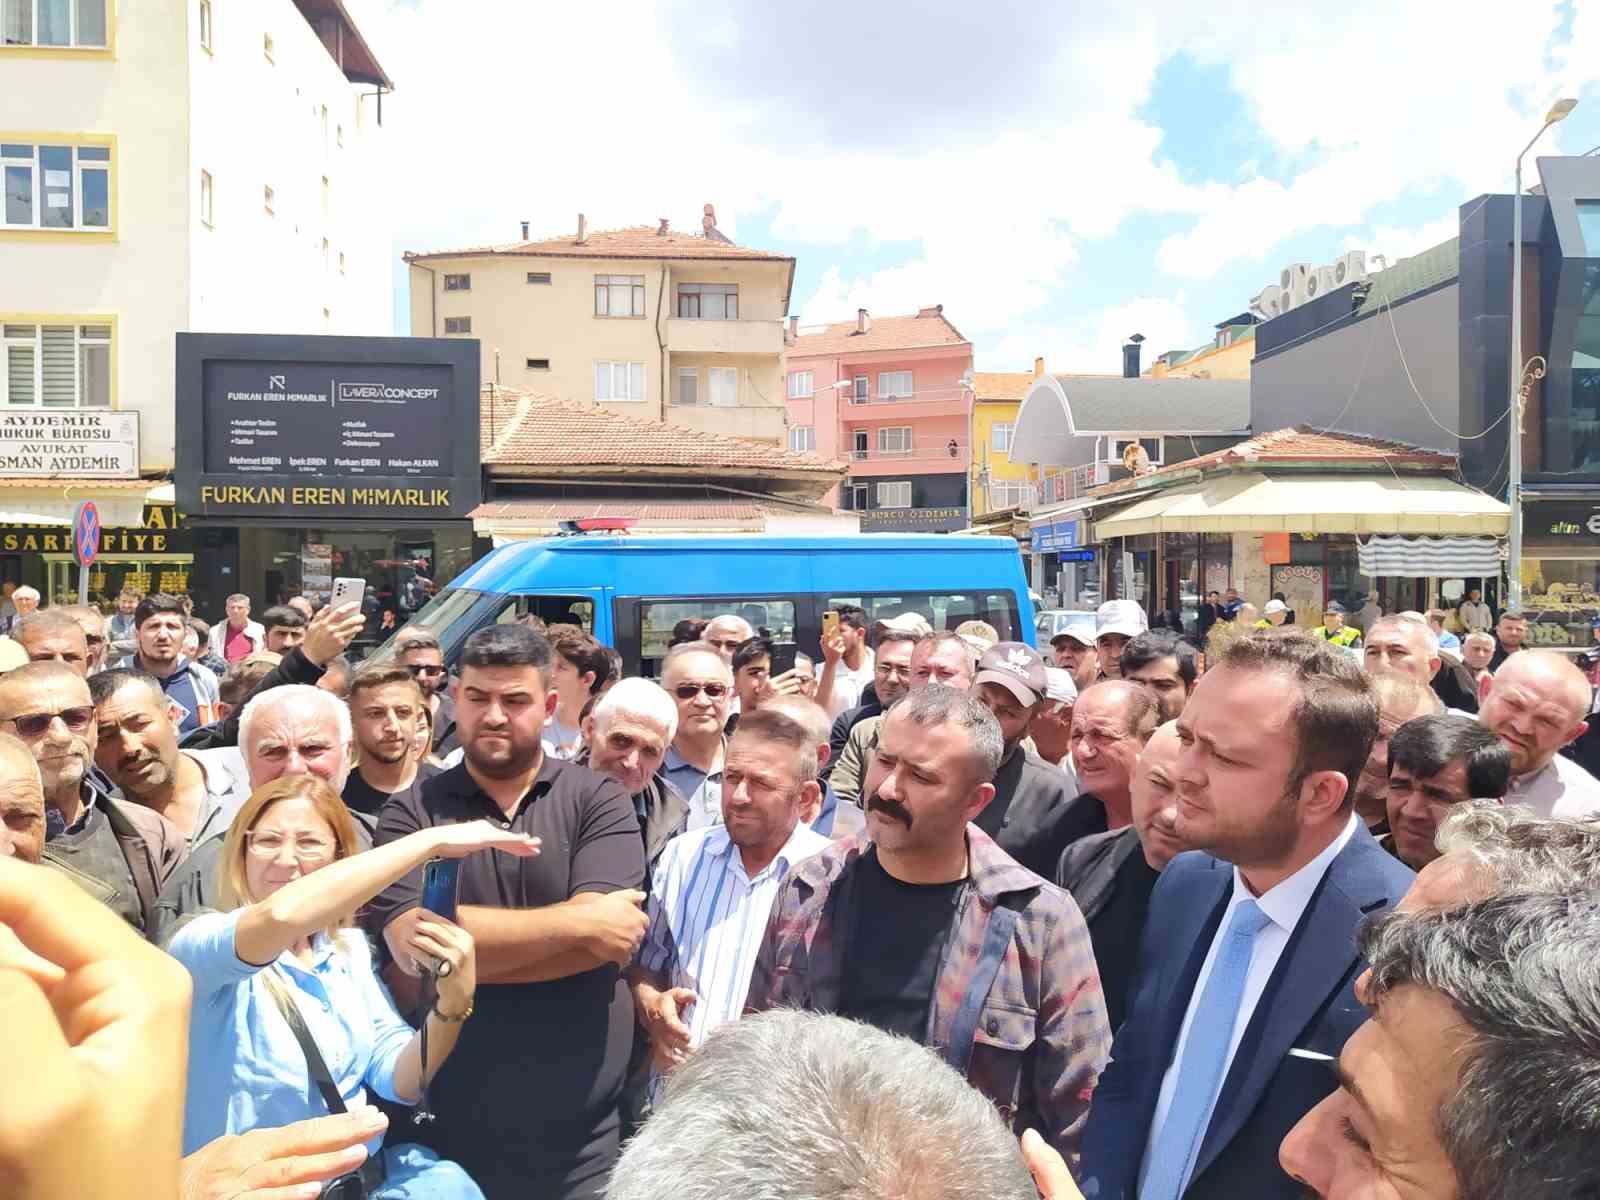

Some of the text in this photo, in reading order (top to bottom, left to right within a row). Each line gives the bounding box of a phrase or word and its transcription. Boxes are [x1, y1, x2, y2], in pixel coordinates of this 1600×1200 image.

[228, 392, 261, 401] FURKAN
[264, 393, 285, 401] EREN
[3, 414, 101, 426] AYDEMİR
[0, 427, 111, 439] UKUK BÜROSU
[20, 444, 88, 453] AVUKAT
[0, 454, 120, 470] SMAN AYDEMİR
[262, 457, 281, 465] EREN
[307, 457, 327, 466] EREN
[361, 458, 381, 466] EREN
[201, 486, 285, 505] FURKAN
[292, 487, 345, 506] EREN
[4, 530, 168, 550] SARFİYE
